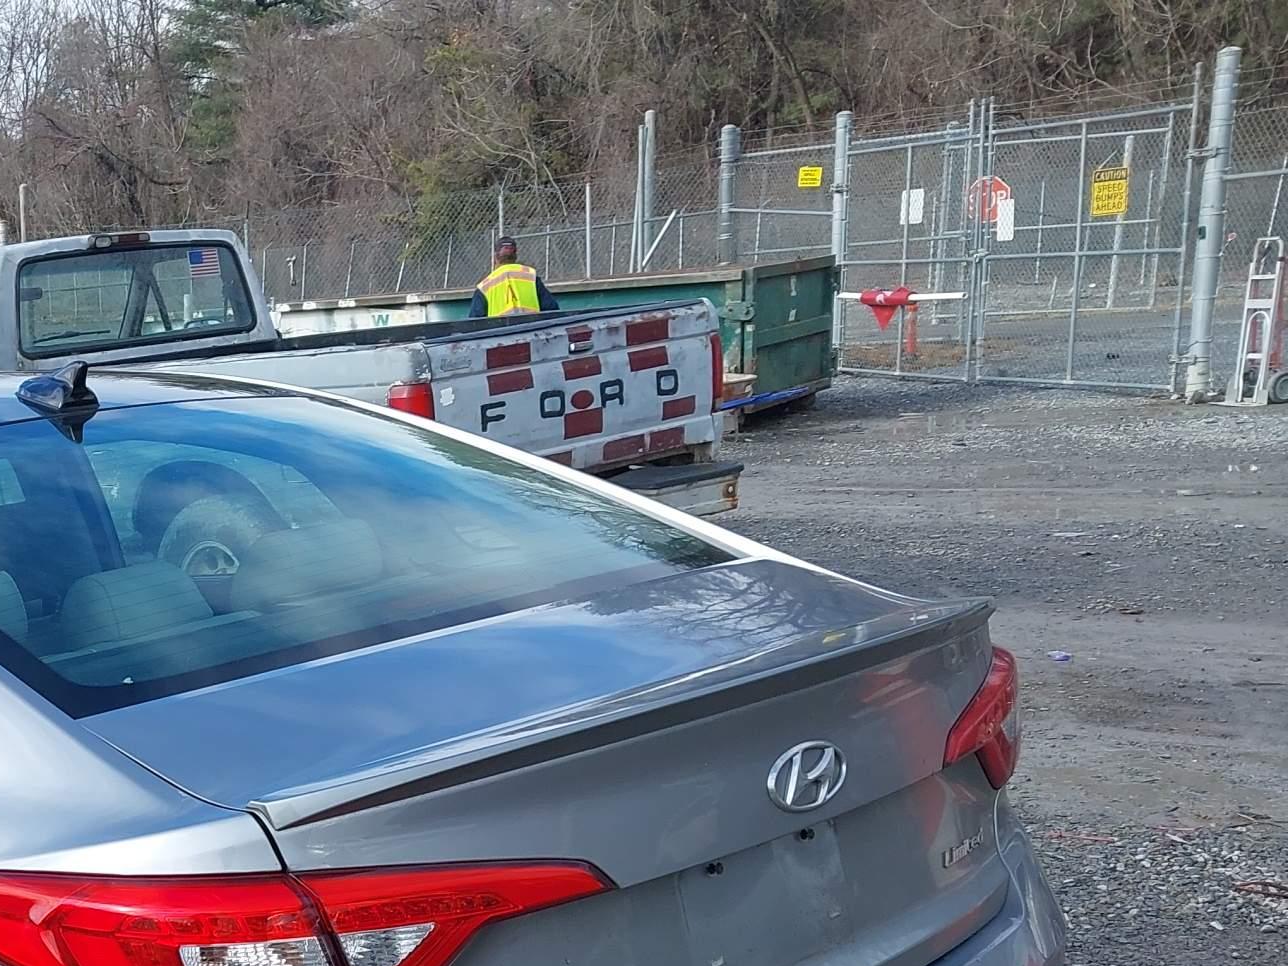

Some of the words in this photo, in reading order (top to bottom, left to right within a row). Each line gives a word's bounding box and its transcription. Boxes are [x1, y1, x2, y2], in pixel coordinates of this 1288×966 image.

[1095, 170, 1126, 181] CAUTION
[1097, 183, 1123, 193] SPEED
[1096, 192, 1123, 202] BUMPS
[1096, 201, 1122, 211] AHEAD
[943, 827, 983, 868] Limited
